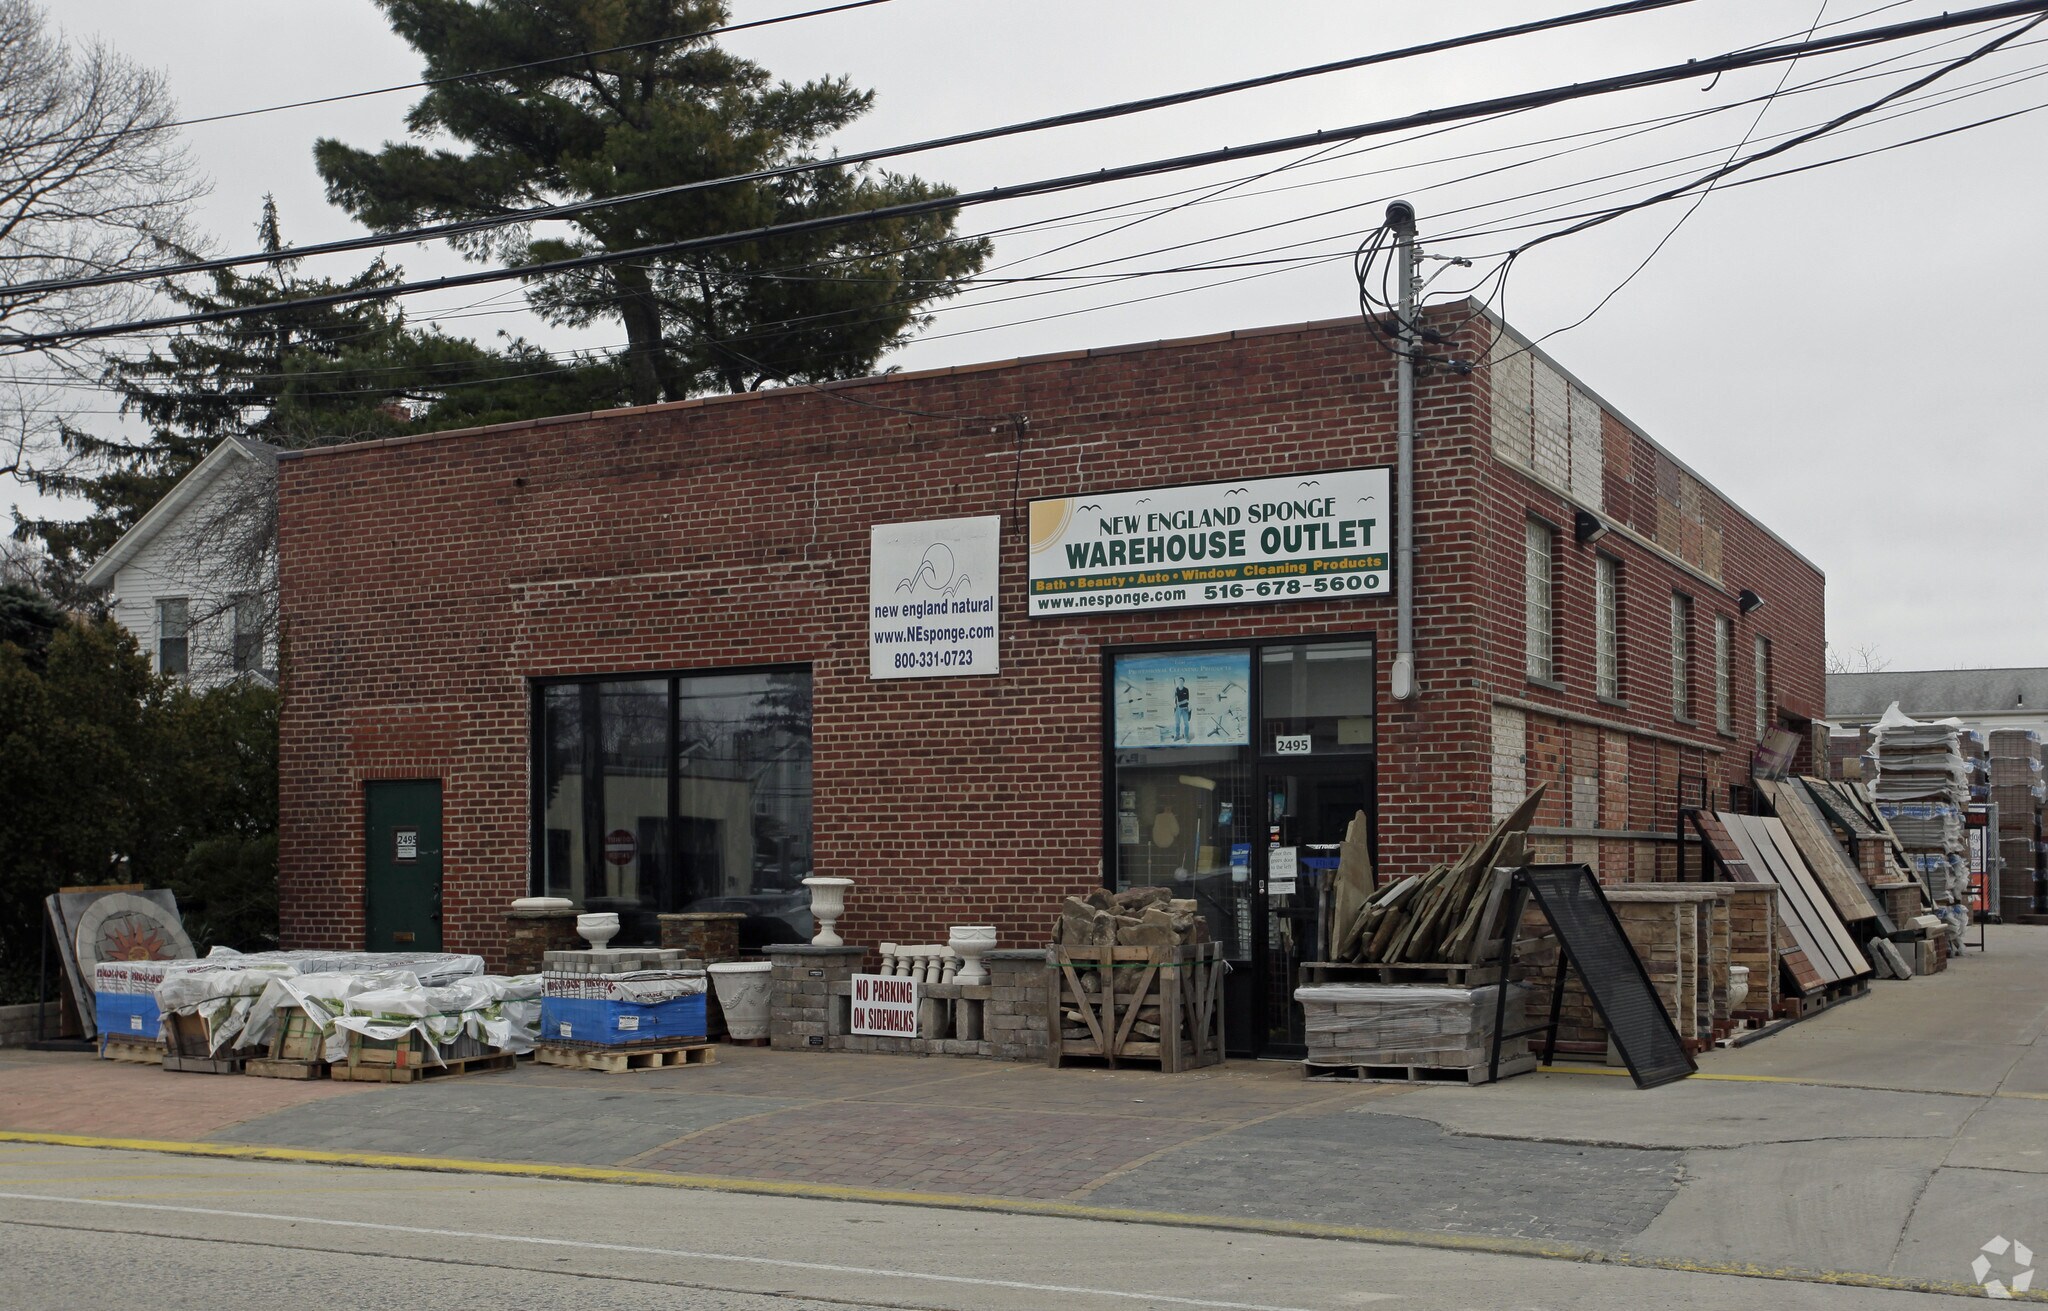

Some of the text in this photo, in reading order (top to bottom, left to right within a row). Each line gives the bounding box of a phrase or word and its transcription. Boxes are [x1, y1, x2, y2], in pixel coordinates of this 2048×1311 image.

[1100, 497, 1336, 536] NEW ENGLAND SPONGE
[1065, 518, 1376, 570] WAREHOUSE OUTLET
[1036, 556, 1382, 591] Bath Beauty Auto Window Cleaning Products
[1038, 574, 1380, 609] www.nesponge.com 516-678-5600
[874, 595, 993, 619] new england natural
[874, 625, 994, 645] www.NEsponge.com
[894, 649, 973, 669] 800-331-0723
[1277, 740, 1308, 751] 2495
[856, 979, 913, 1003] NO PARKING
[853, 1007, 914, 1032] ON SIDEWALKS
